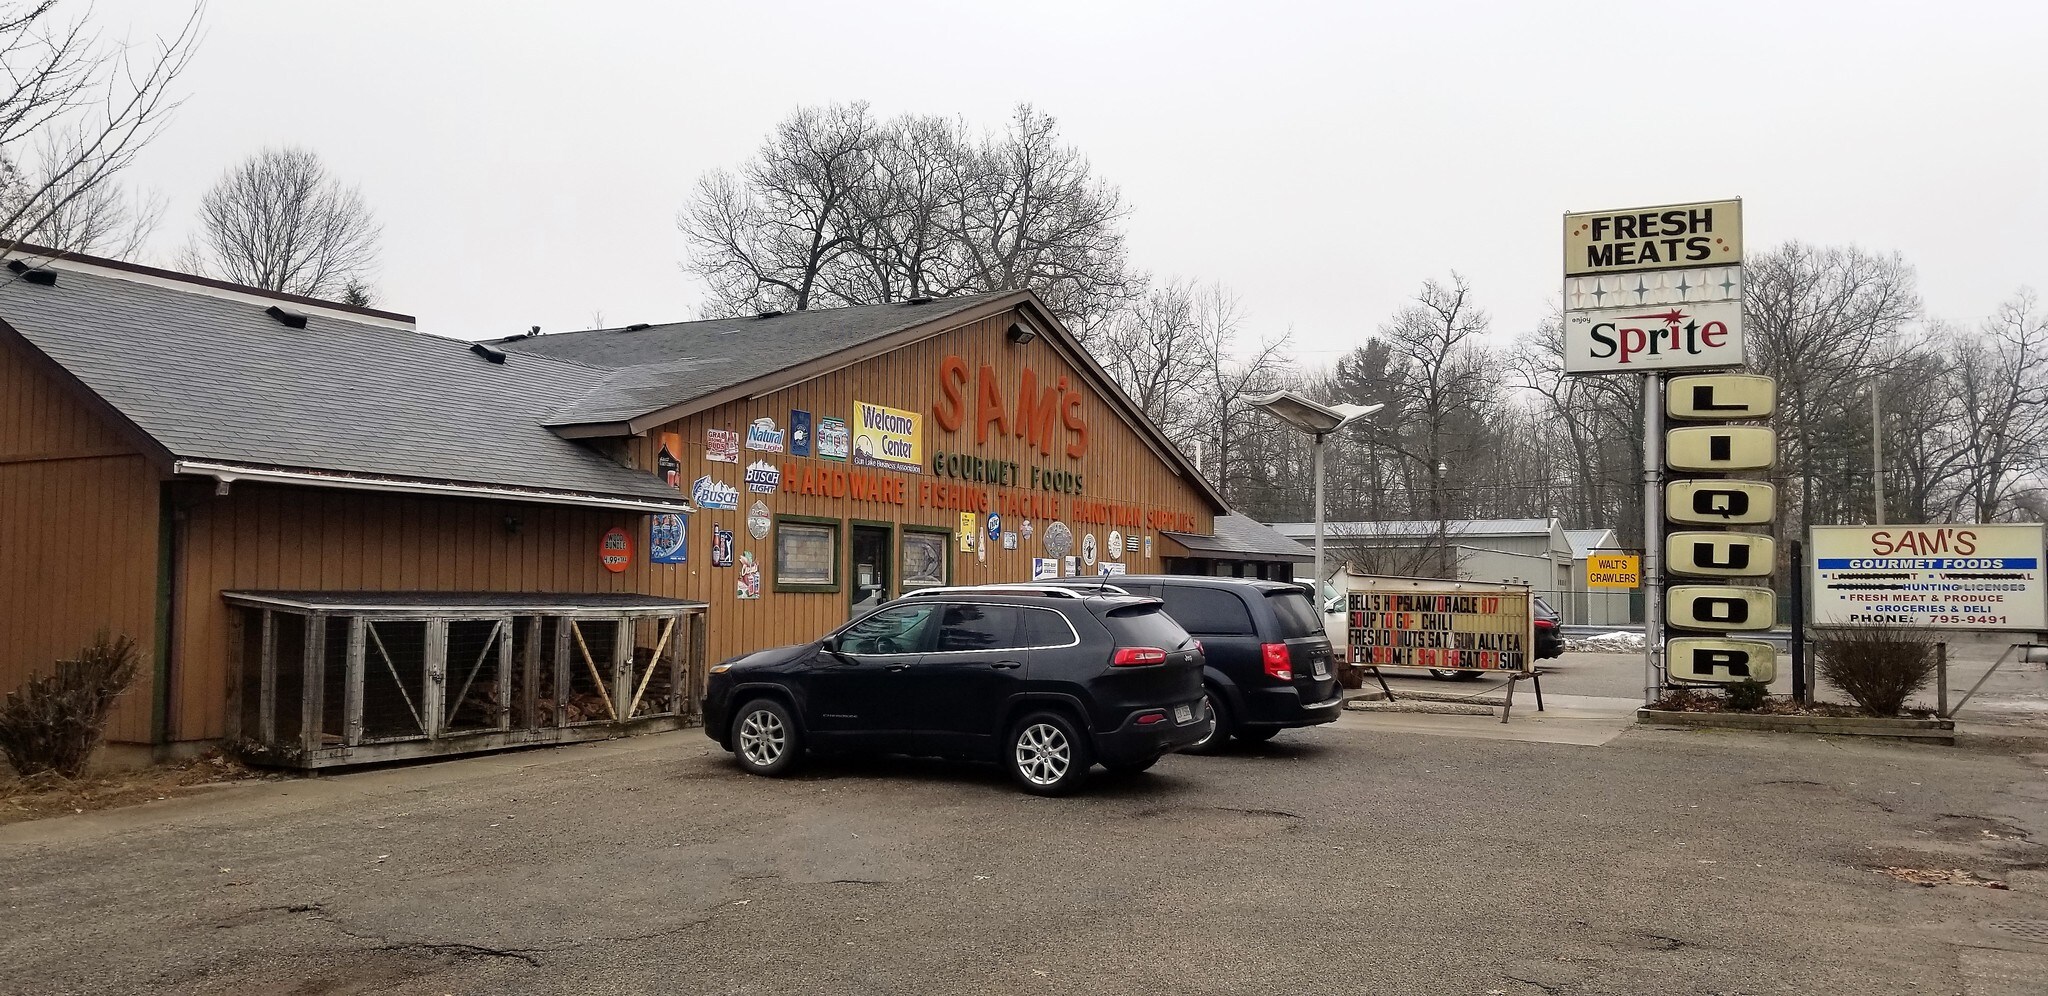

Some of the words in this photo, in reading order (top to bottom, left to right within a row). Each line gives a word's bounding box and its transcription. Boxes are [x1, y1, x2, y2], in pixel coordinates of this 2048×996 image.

[1592, 208, 1713, 242] FRESH
[1587, 237, 1711, 268] MEATS
[1590, 318, 1728, 364] Sprite
[933, 355, 1088, 460] SAM'S
[862, 404, 913, 436] Welcome
[748, 424, 785, 446] Natural
[763, 443, 783, 452] Light
[882, 434, 912, 459] Center
[854, 456, 865, 466] Gun
[865, 458, 877, 467] Lake
[877, 460, 896, 470] Business
[896, 463, 921, 474] Association
[932, 450, 1019, 488] GOURMET
[1030, 465, 1083, 495] FOODS
[745, 469, 780, 484] BUSCH
[700, 489, 739, 504] BUSCH
[749, 484, 776, 494] LIGHT
[783, 462, 905, 505] HARDWARE
[919, 480, 989, 514] FISHING
[998, 491, 1060, 521] TACKLE
[1072, 499, 1142, 529] HANDYMAN
[1147, 508, 1196, 534] SUPPLIES
[1692, 385, 1751, 677] LIQUOR
[1871, 528, 1977, 556] SAM'S
[1598, 559, 1628, 570] WALT'S
[1849, 558, 1938, 570] GOURMET
[1942, 558, 2004, 570] FOODS
[1902, 583, 1960, 592] HUNTING
[1964, 584, 2026, 592] LICENSES
[1348, 594, 1381, 611] BELL'S
[1849, 594, 1889, 602] FRESH
[1892, 594, 1927, 602] MEAT
[1930, 594, 1940, 602] &
[1944, 594, 2005, 603] PRODUCE
[1875, 604, 1946, 613] GROCERIES
[1950, 605, 1960, 613] &
[1963, 605, 1992, 613] DELI
[1349, 611, 1377, 628] SOUP
[1379, 612, 1393, 629] TO
[1421, 612, 1453, 631] CHILI
[1849, 613, 1914, 623] PHONE:
[1929, 615, 2008, 625] 795-9491
[1348, 628, 1382, 647] FRESH
